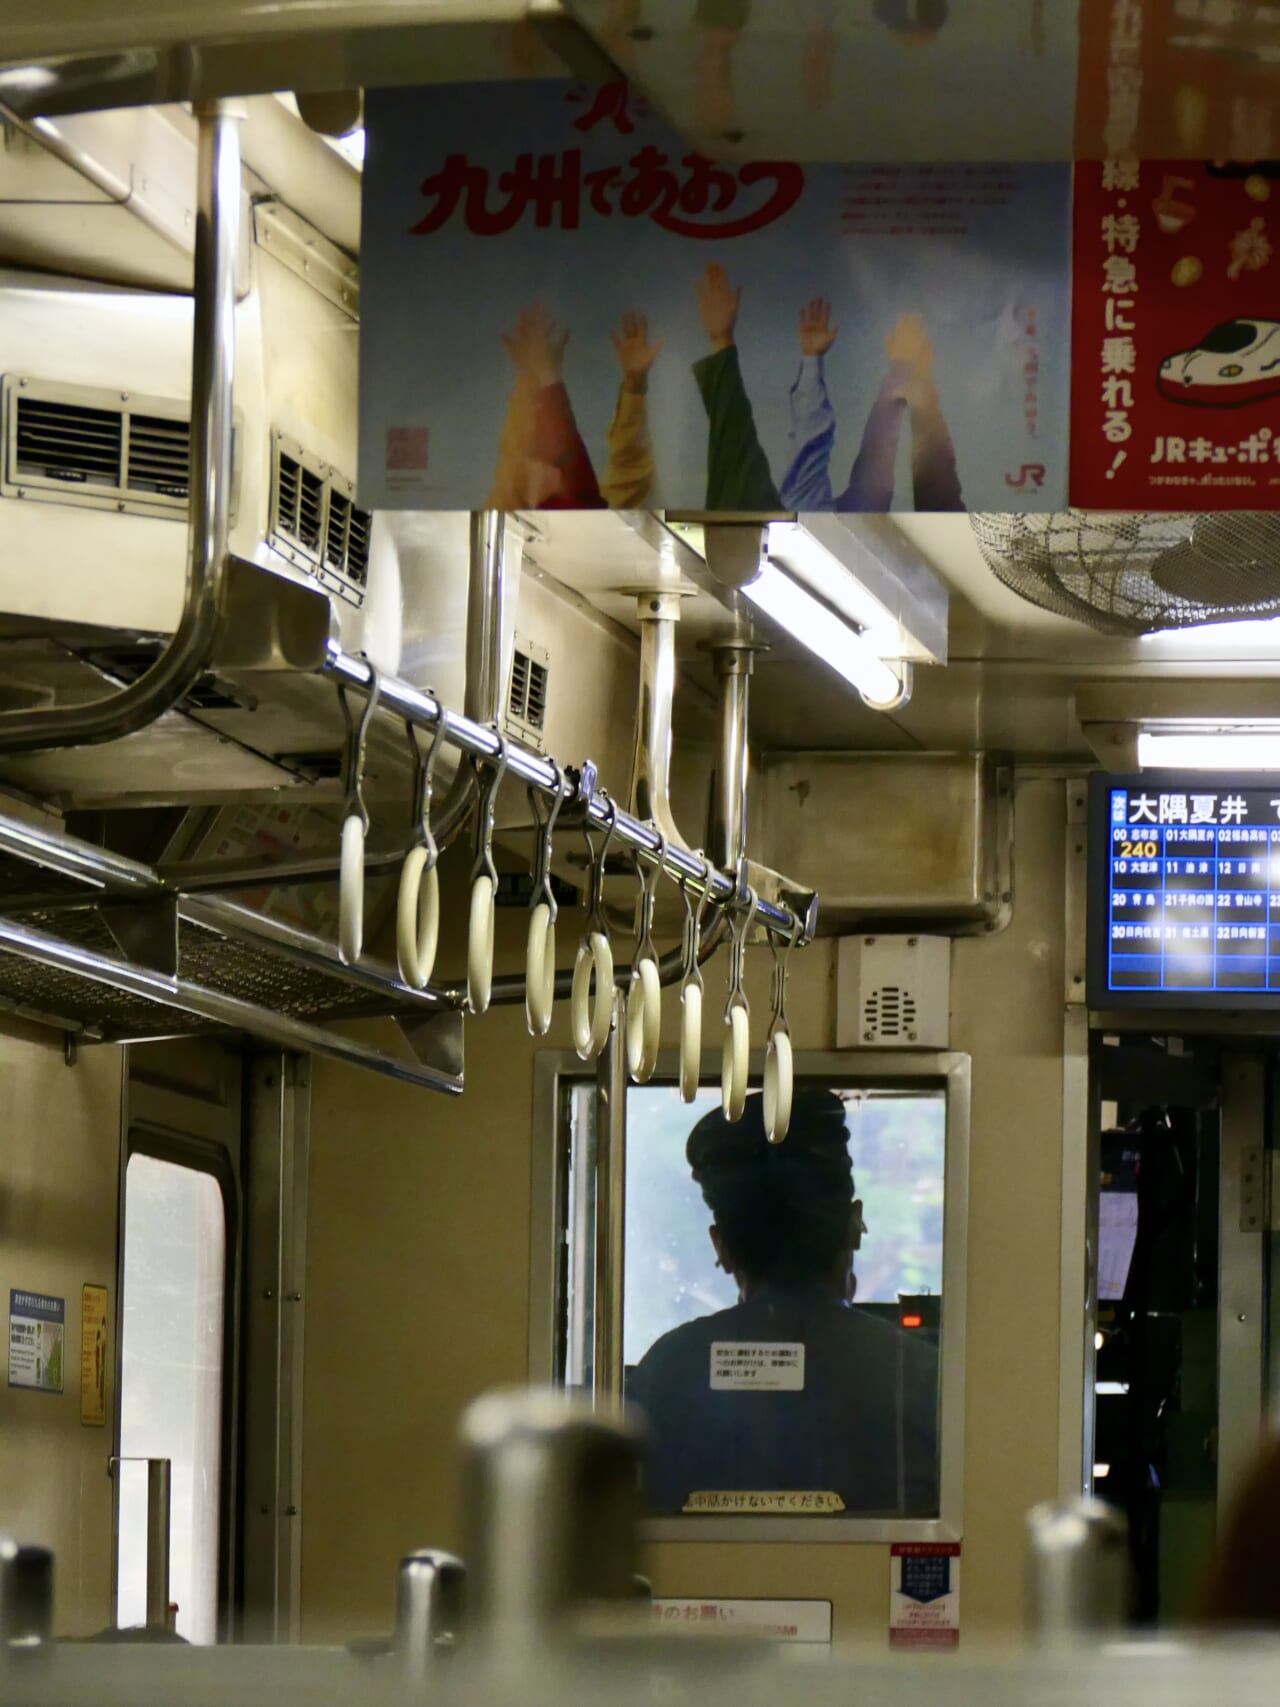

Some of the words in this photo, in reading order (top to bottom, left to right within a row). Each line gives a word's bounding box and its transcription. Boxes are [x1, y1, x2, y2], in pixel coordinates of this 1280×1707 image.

[409, 146, 804, 239] 九州であおう
[1128, 793, 1248, 824] 大隅夏井
[1113, 829, 1127, 841] 00
[1120, 842, 1157, 858] 240
[1113, 861, 1127, 873] 10
[1166, 861, 1178, 873] 11
[1219, 862, 1231, 874] 12
[1112, 893, 1126, 906] 20
[1217, 894, 1231, 907] 22
